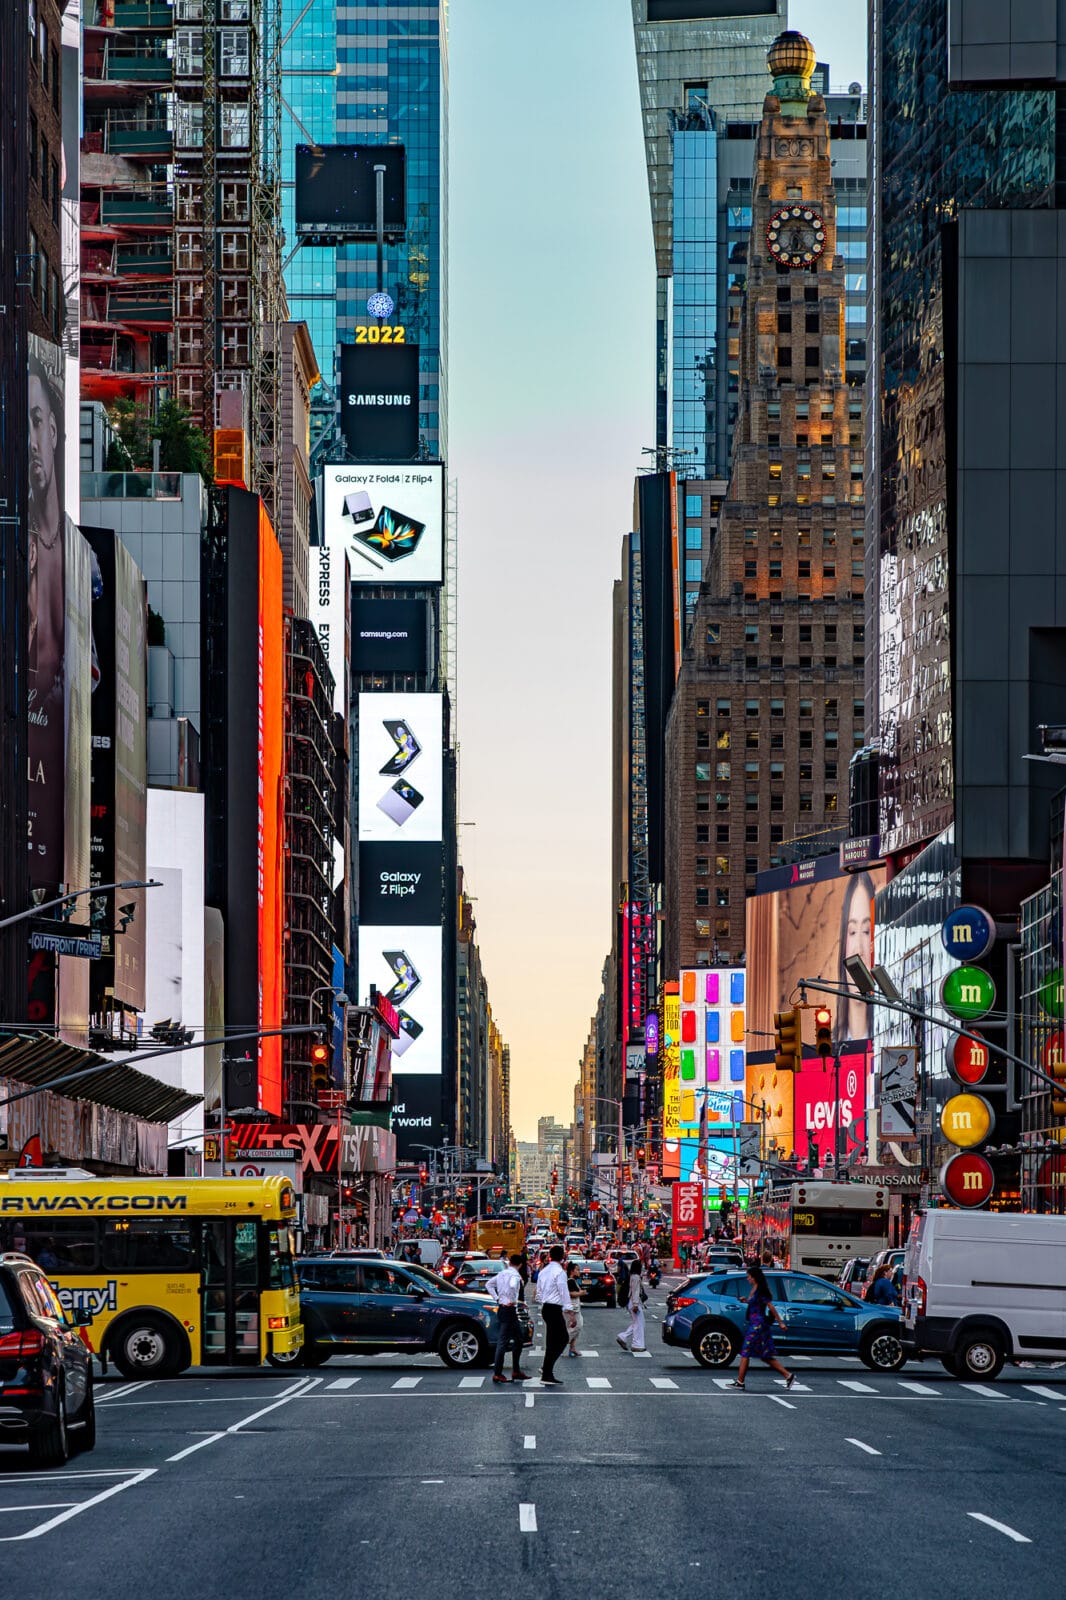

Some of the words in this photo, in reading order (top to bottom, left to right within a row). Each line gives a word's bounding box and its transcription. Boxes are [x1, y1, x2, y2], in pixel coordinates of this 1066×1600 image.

[355, 326, 405, 344] 2022
[348, 394, 411, 406] SAMSUNG
[335, 475, 368, 485] Galaxy
[369, 475, 375, 483] Z
[376, 475, 400, 483] Fold4
[405, 475, 411, 483] Z
[412, 475, 433, 486] Flip4
[360, 631, 408, 640] samsung.com
[91, 735, 111, 749] ES
[845, 839, 870, 850] MARRIOTT
[845, 849, 868, 860] MARQUIS
[380, 871, 421, 884] Galaxy
[380, 885, 388, 894] Z
[389, 884, 415, 897] Flip4
[952, 923, 972, 943] m
[960, 984, 981, 1003] m
[666, 1020, 680, 1030] TOD
[970, 1047, 985, 1066] m
[880, 1090, 917, 1104] MORMON
[397, 1116, 432, 1127] world
[952, 1111, 972, 1129] m
[258, 1125, 323, 1172] TSX
[963, 1171, 983, 1190] m
[680, 1185, 699, 1222] tkts
